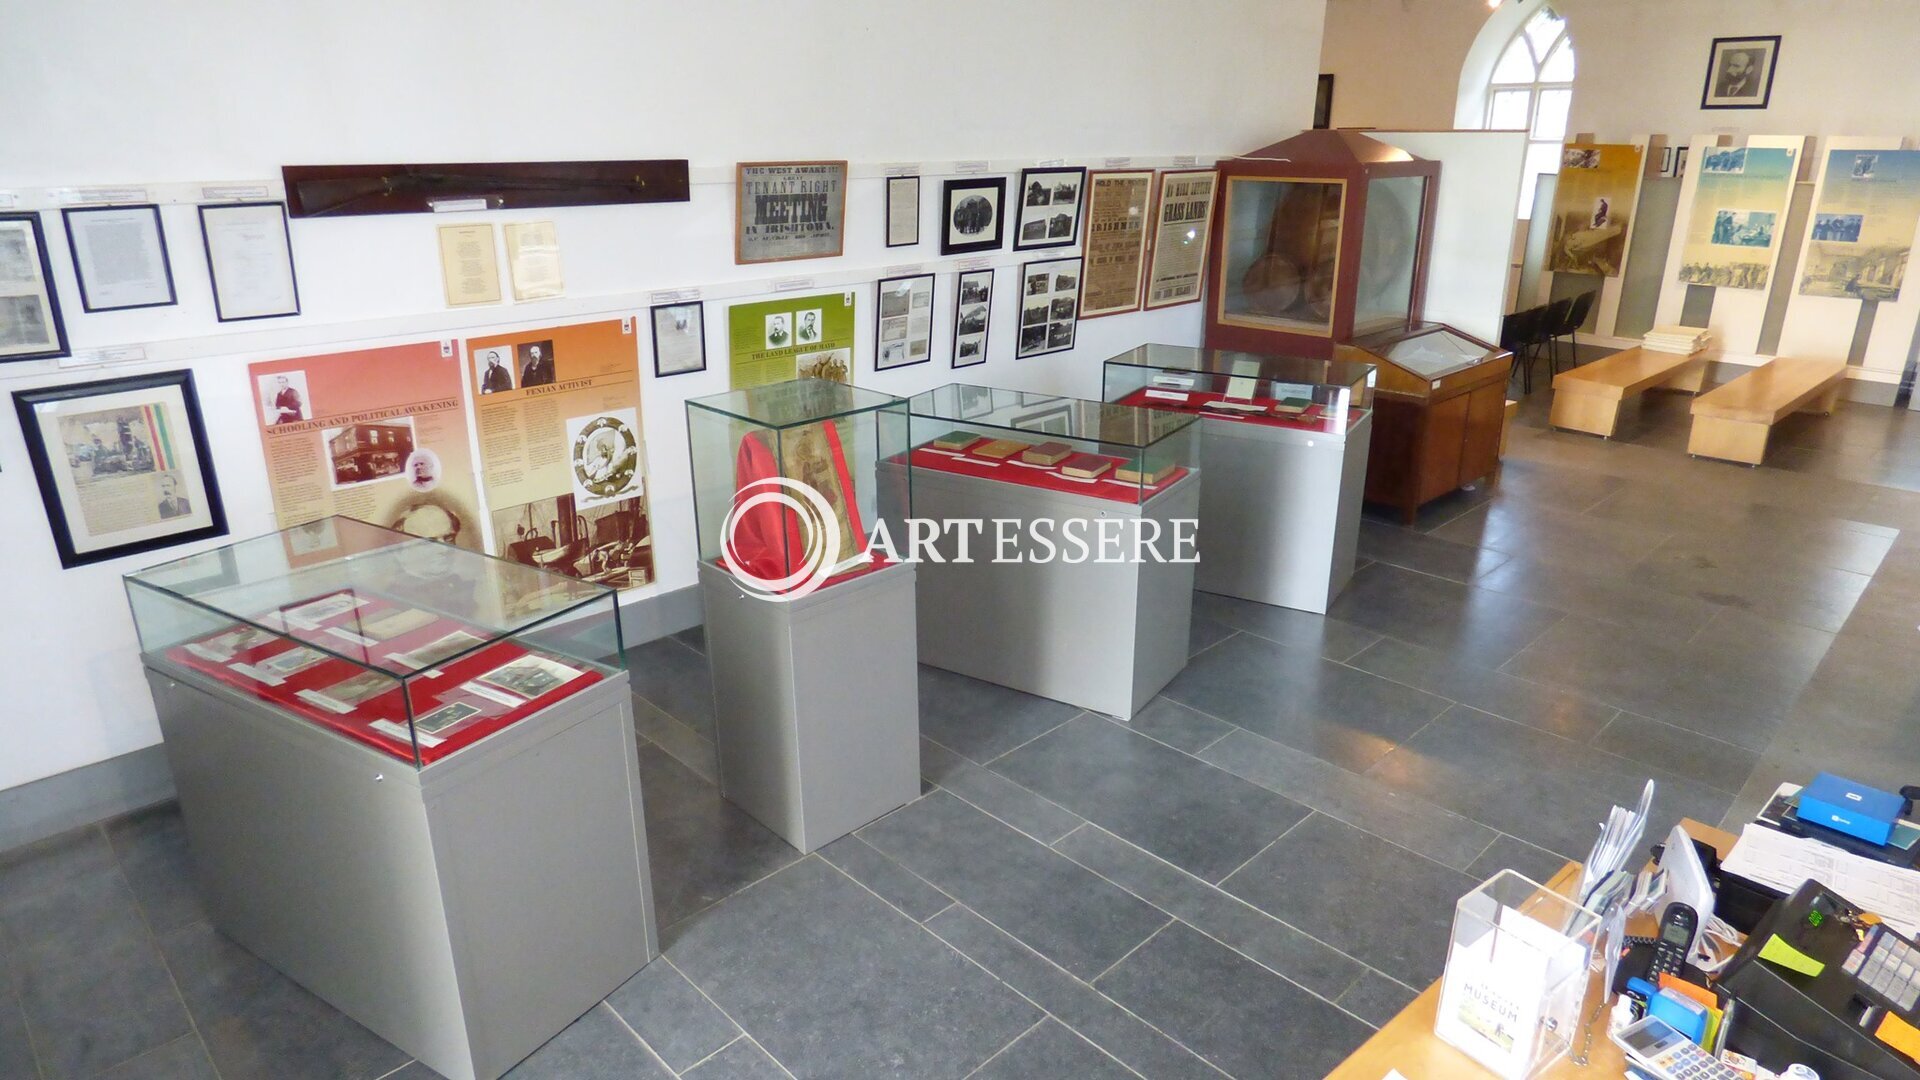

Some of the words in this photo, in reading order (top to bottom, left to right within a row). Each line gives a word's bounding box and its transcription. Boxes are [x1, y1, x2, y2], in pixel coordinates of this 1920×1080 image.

[768, 166, 793, 174] WEST
[746, 181, 795, 195] TENANT
[800, 180, 837, 193] RIGHT
[755, 193, 828, 225] MEETING
[526, 384, 557, 396] FENIAN
[559, 379, 593, 391] ACTIVIST
[267, 420, 326, 435] SCHOOLING
[328, 417, 349, 427] AND
[351, 407, 402, 423] POLITICAL
[404, 400, 459, 415] AWAKENING
[1464, 983, 1517, 1022] MUSEUM
